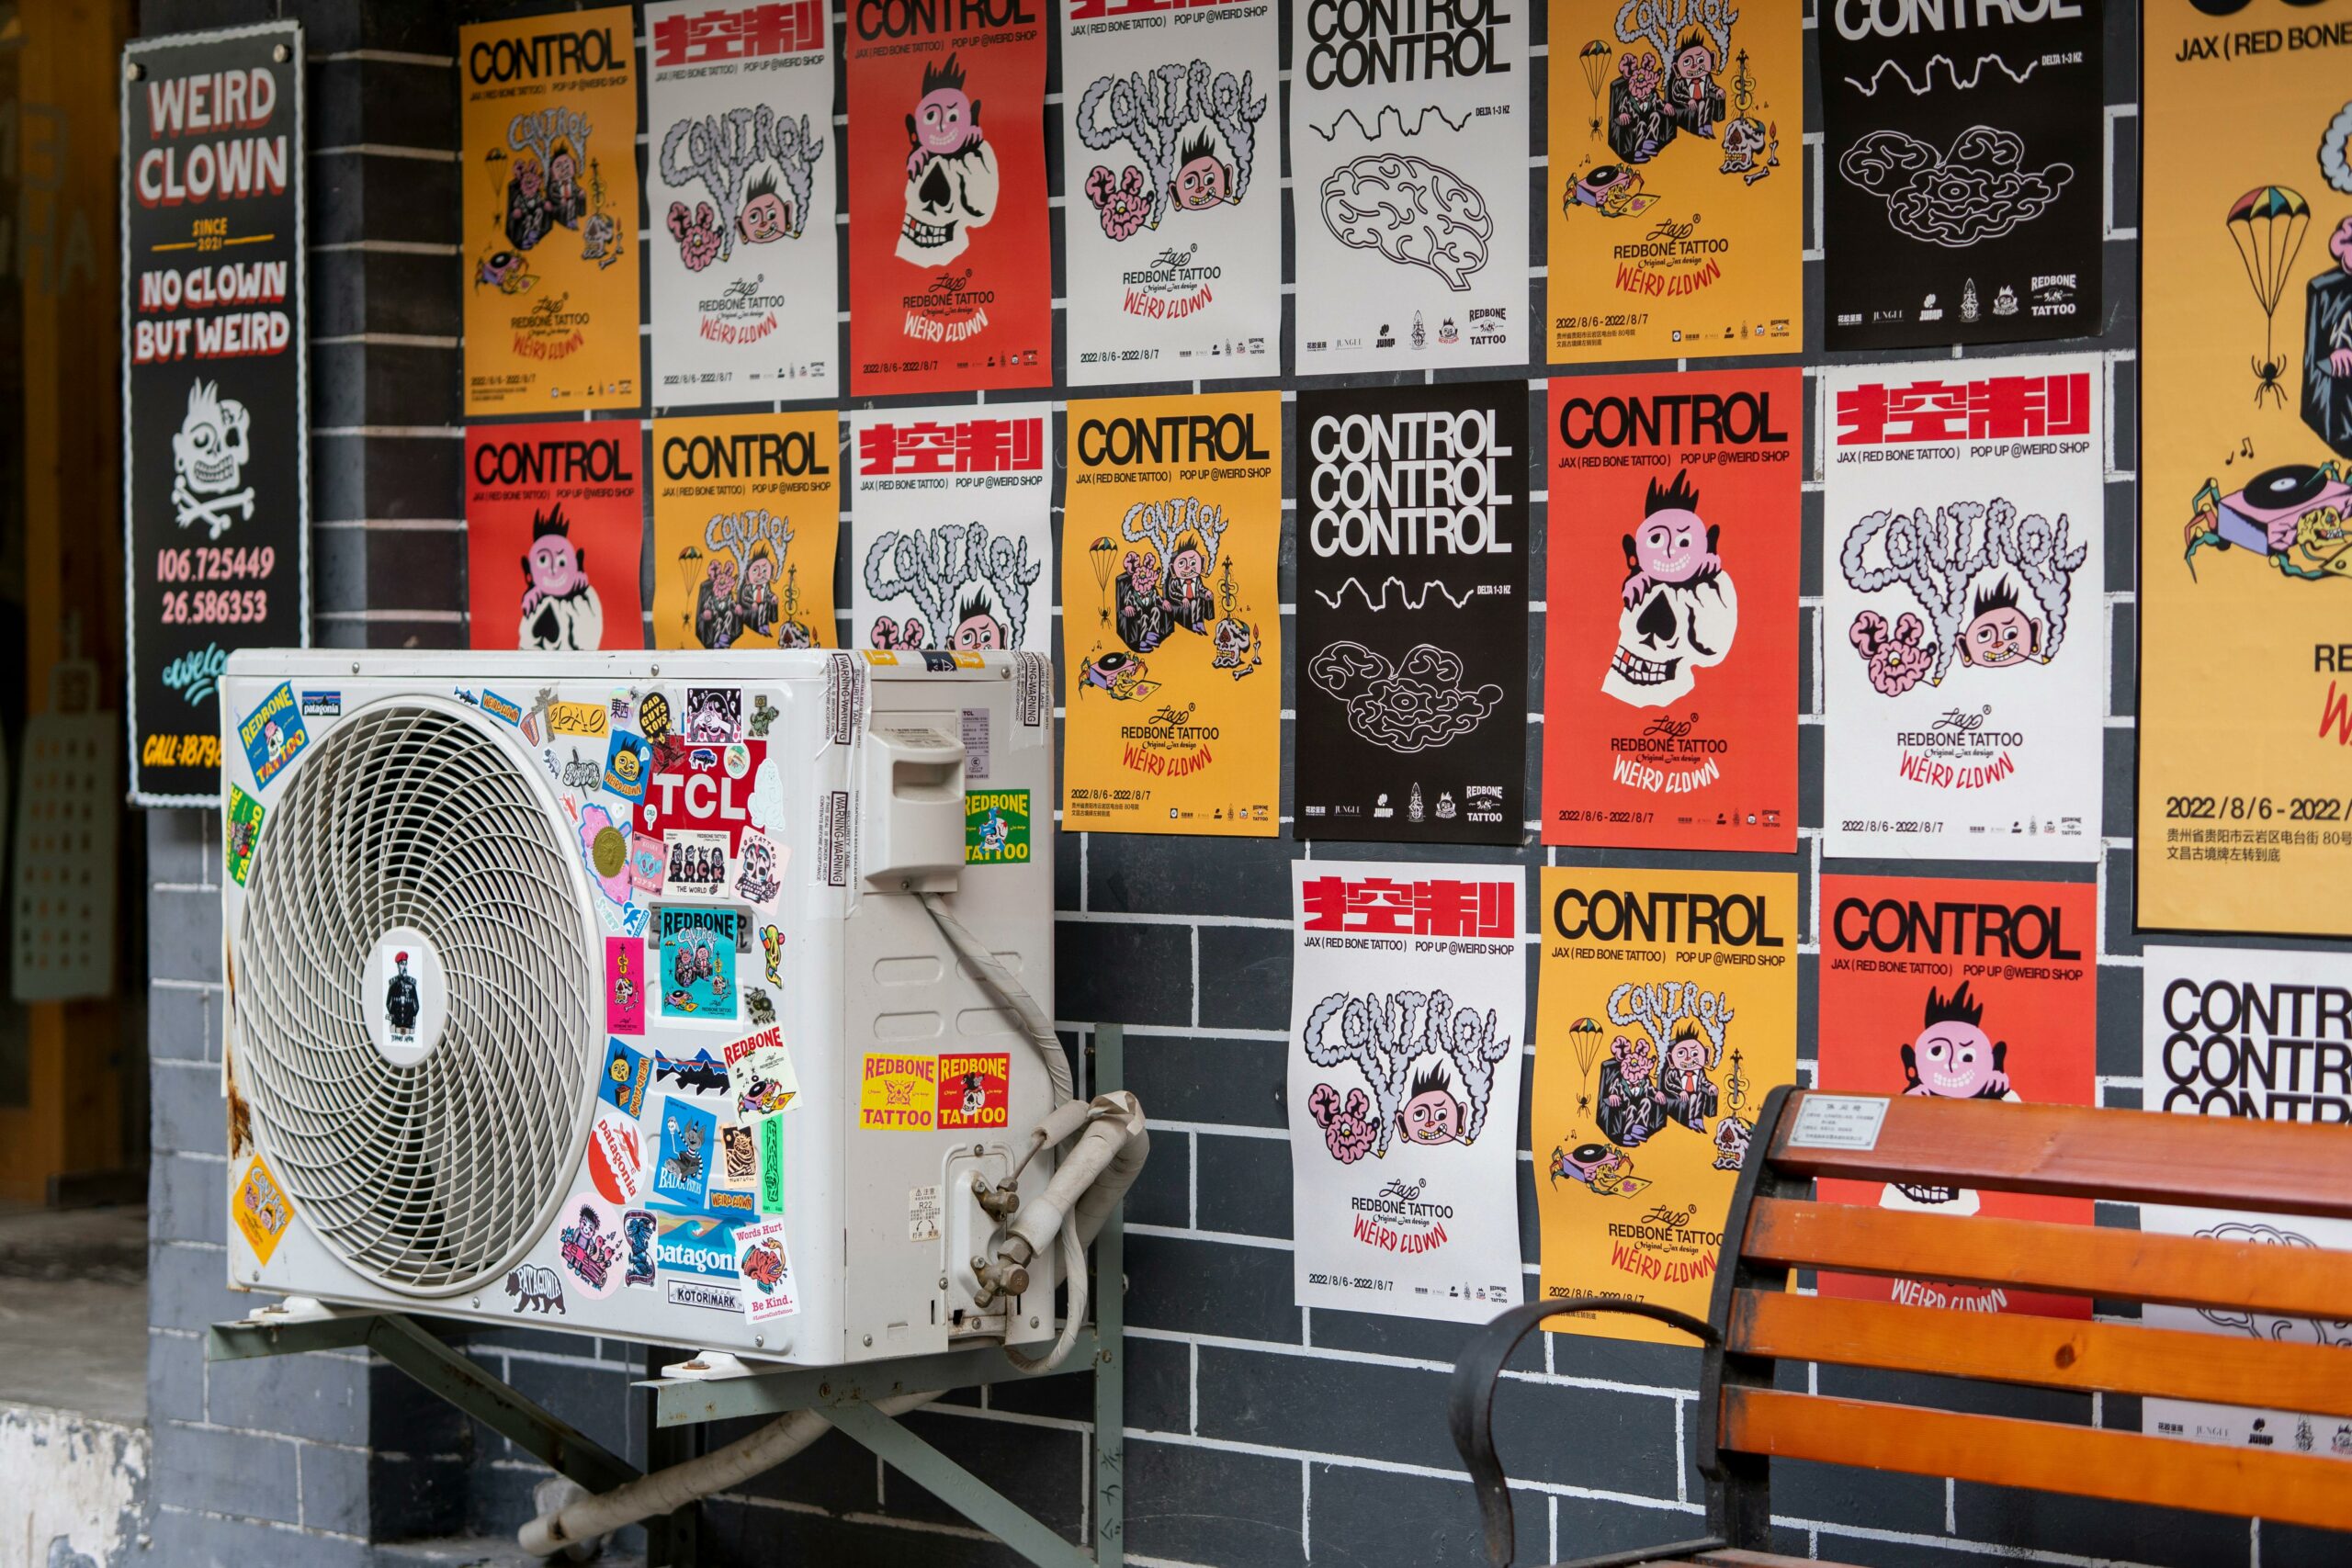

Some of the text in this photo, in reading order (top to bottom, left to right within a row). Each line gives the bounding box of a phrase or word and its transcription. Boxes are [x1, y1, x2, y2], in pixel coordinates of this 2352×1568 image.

[654, 1, 824, 67] 控制
[1307, 0, 1510, 42] CONTROL
[470, 28, 626, 85] CONTROL
[1306, 27, 1511, 90] CONTROL
[2041, 54, 2060, 65] DELTA
[2074, 51, 2082, 62] HZ
[2176, 35, 2220, 62] JAX
[2288, 21, 2352, 51] BONE
[148, 67, 276, 137] WEIRD
[1476, 107, 1492, 117] DELTA
[1503, 105, 1510, 114] HZ
[135, 135, 287, 209] CLOWN
[192, 218, 227, 237] SINCE
[198, 237, 221, 251] 2021
[1613, 239, 1728, 259] REDBONE TATTOO
[140, 261, 287, 312] NO CLOWN
[1123, 266, 1221, 285] REDBONE TATTOO
[1615, 257, 1721, 297] WEIRD CLOWN
[2031, 275, 2076, 291] REDBONE
[1124, 283, 1213, 319] WEIRD CLOWN
[1470, 308, 1506, 322] REDBONE
[2031, 303, 2076, 317] TATTOO
[133, 311, 289, 365] BUT WEIRD
[700, 311, 777, 345] WEIRD CLOWN
[905, 307, 988, 342] WEIRD CLOWN
[1470, 334, 1506, 345] TATTOO
[1560, 391, 1788, 449] CONTROL
[1837, 373, 2089, 446] 控制
[860, 418, 1043, 475] 控制
[1078, 413, 1269, 467] CONTROL
[1310, 409, 1512, 462] CONTROL
[1837, 451, 1856, 464] JAX
[1885, 449, 1915, 461] BONE
[1971, 446, 1992, 457] POP
[1995, 445, 2009, 457] UP
[2010, 443, 2057, 458] @WEIRD
[2058, 441, 2089, 454] SHOP
[475, 439, 632, 485] CONTROL
[663, 432, 829, 479] CONTROL
[1310, 457, 1512, 511] CONTROL
[1310, 505, 1512, 558] CONTROL
[157, 547, 275, 582] 106.725449
[162, 590, 266, 624] 26.586353
[642, 694, 660, 714] BAD
[1024, 652, 1036, 722] ARNING-WARNING
[242, 685, 293, 750] REDBONE
[304, 704, 339, 715] patagonia
[641, 703, 667, 726] GUYS
[645, 715, 668, 733] TOYS
[1121, 727, 1219, 739] REDBONE TATTOO
[1611, 738, 1727, 753] REDBONE TATTOO
[1897, 732, 2023, 747] REDBONE TATTOO
[1123, 741, 1212, 776] WEIRD CLOWN
[1612, 753, 1720, 794] WEIRD CLOWN
[1900, 750, 2014, 789] WEIRD CLOWN
[652, 773, 746, 819] TCL
[966, 795, 1028, 817] REDBONE
[1466, 785, 1503, 799] REDBONE
[1466, 812, 1503, 822] TATTOO
[832, 796, 845, 882] WARNING-WARNING
[672, 864, 722, 879] FUCK
[676, 886, 687, 894] THE
[634, 911, 649, 938] TAGONIA
[1303, 876, 1514, 939] 控制
[1554, 888, 1783, 948] CONTROL
[663, 912, 734, 941] REDBONE
[1833, 897, 2082, 960] CONTROL
[2163, 977, 2352, 1040] CONTR
[724, 1026, 784, 1067] REDBONE
[2163, 1032, 2352, 1095] CONTR
[637, 1057, 650, 1089] WEIRD
[865, 1058, 934, 1084] REDBONE
[940, 1058, 1007, 1082] REDBONE
[864, 1109, 932, 1126] TATTOO
[941, 1107, 1006, 1124] TATTOO
[2163, 1085, 2352, 1124] CONTR
[598, 1120, 637, 1196] patagonia
[711, 1194, 732, 1208] WEIRD
[919, 1201, 933, 1209] R22
[1351, 1197, 1453, 1219] REDBONE TATTOO
[736, 1223, 783, 1241] Words Hurt
[1353, 1213, 1448, 1254] WEIRD CLOWN
[1609, 1224, 1672, 1242] REDBONE
[1634, 1240, 1662, 1251] Original
[1679, 1246, 1699, 1255] design
[1611, 1240, 1717, 1283] WEIRD CLOWN
[516, 1267, 561, 1299] PATAGONIA
[678, 1290, 735, 1307] KOTORIMARK
[1892, 1278, 1946, 1309] WEIRD
[752, 1295, 793, 1312] Be Kind.
